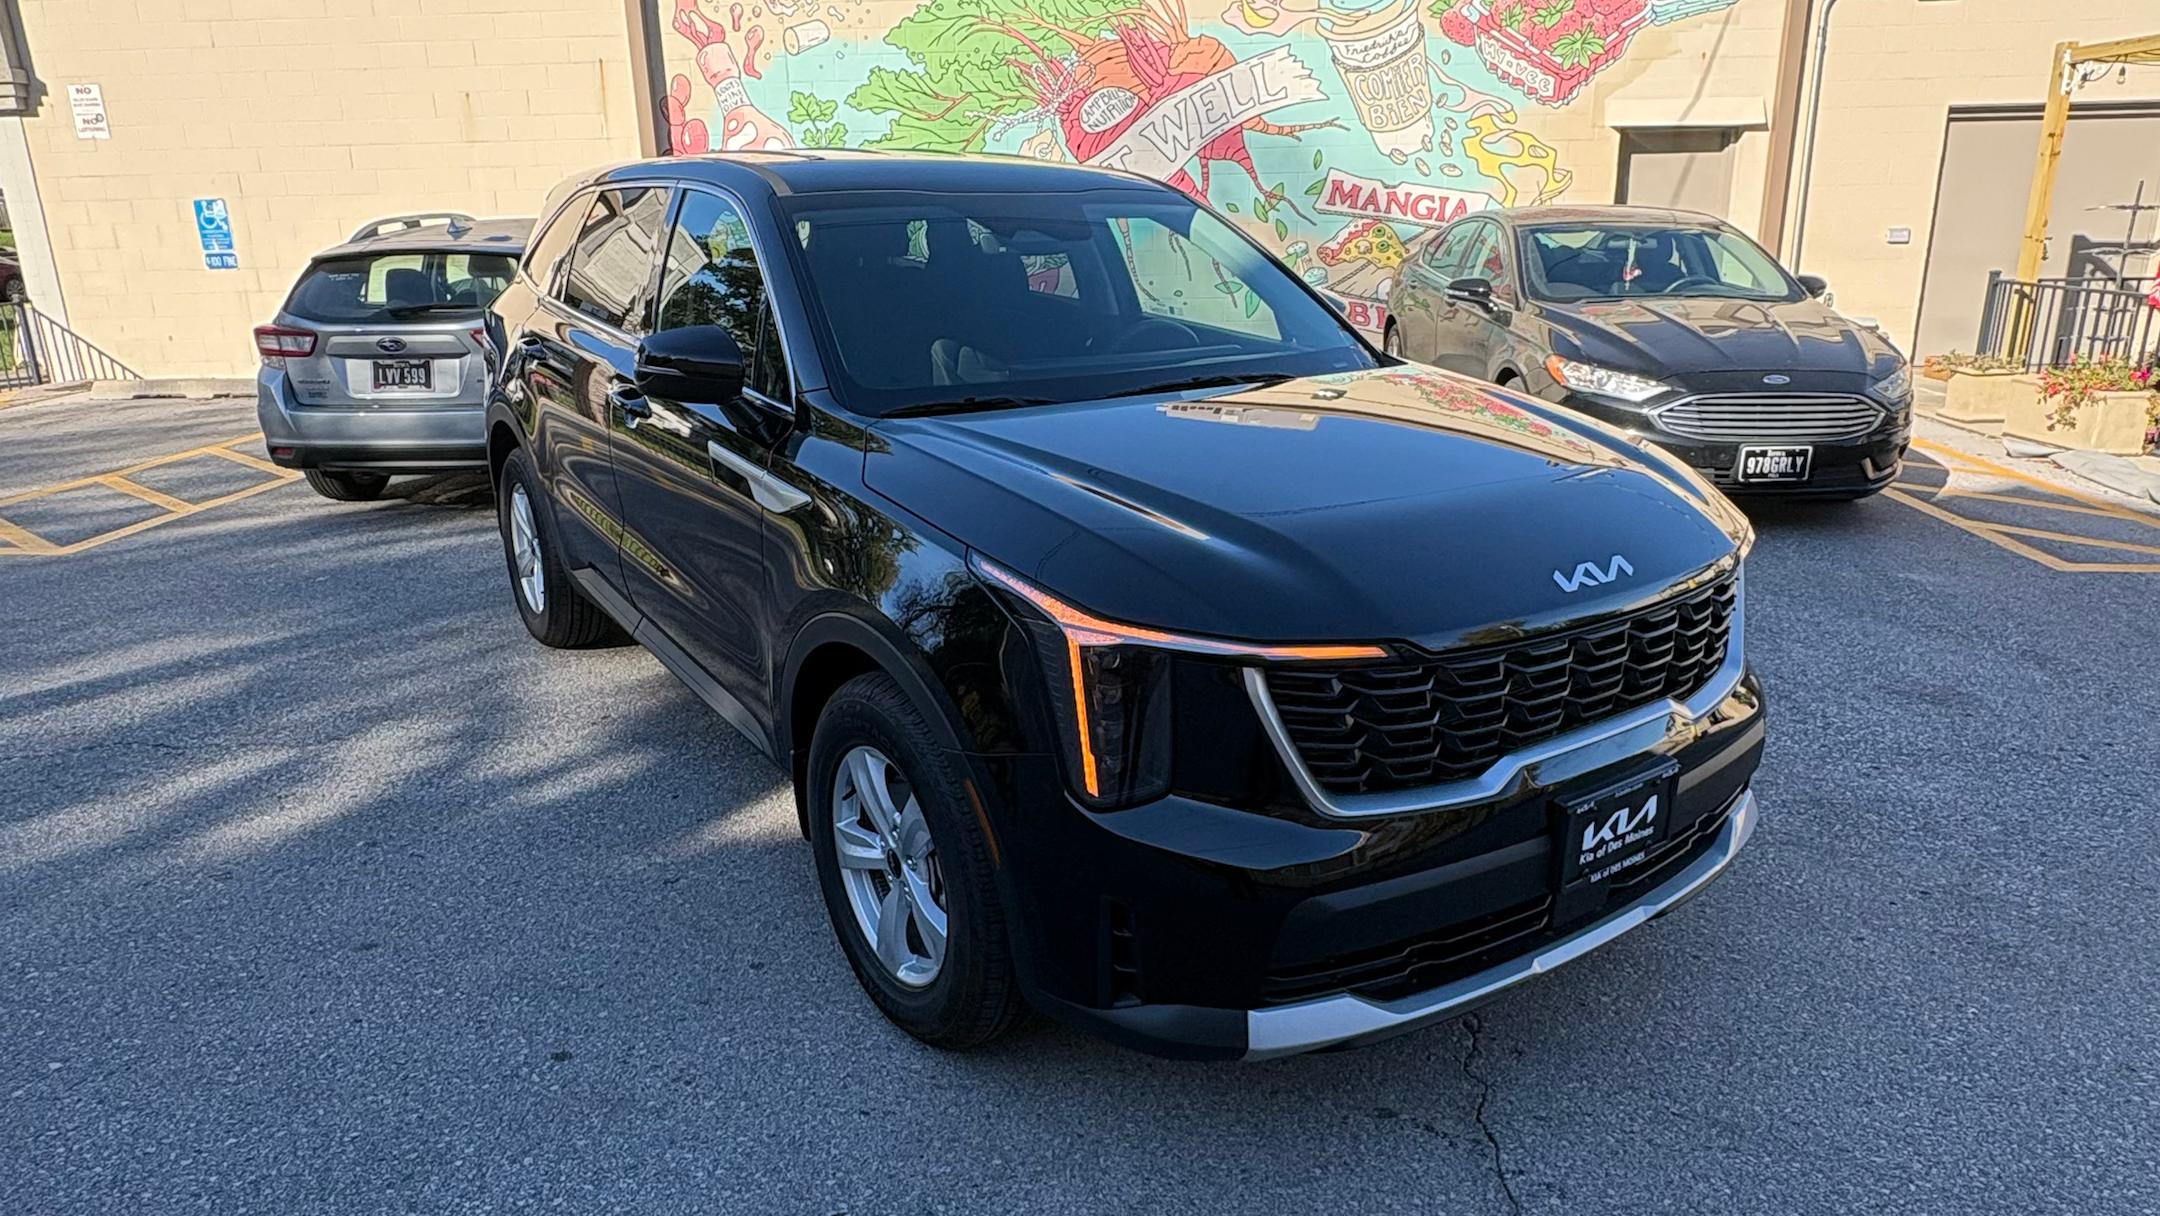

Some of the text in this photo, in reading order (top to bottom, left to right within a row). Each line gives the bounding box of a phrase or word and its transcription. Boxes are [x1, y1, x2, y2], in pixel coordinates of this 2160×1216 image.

[1363, 36, 1411, 63] Coffee
[75, 87, 92, 95] NO
[82, 117, 98, 125] NO
[1139, 62, 1288, 163] WELL
[1326, 179, 1468, 224] MANGIA
[378, 367, 426, 384] LVV 599
[1746, 456, 1804, 474] 978GRLY
[1552, 555, 1634, 593] KIA
[1582, 794, 1658, 851] KIA
[1579, 826, 1655, 865] Kia of Des Moines
